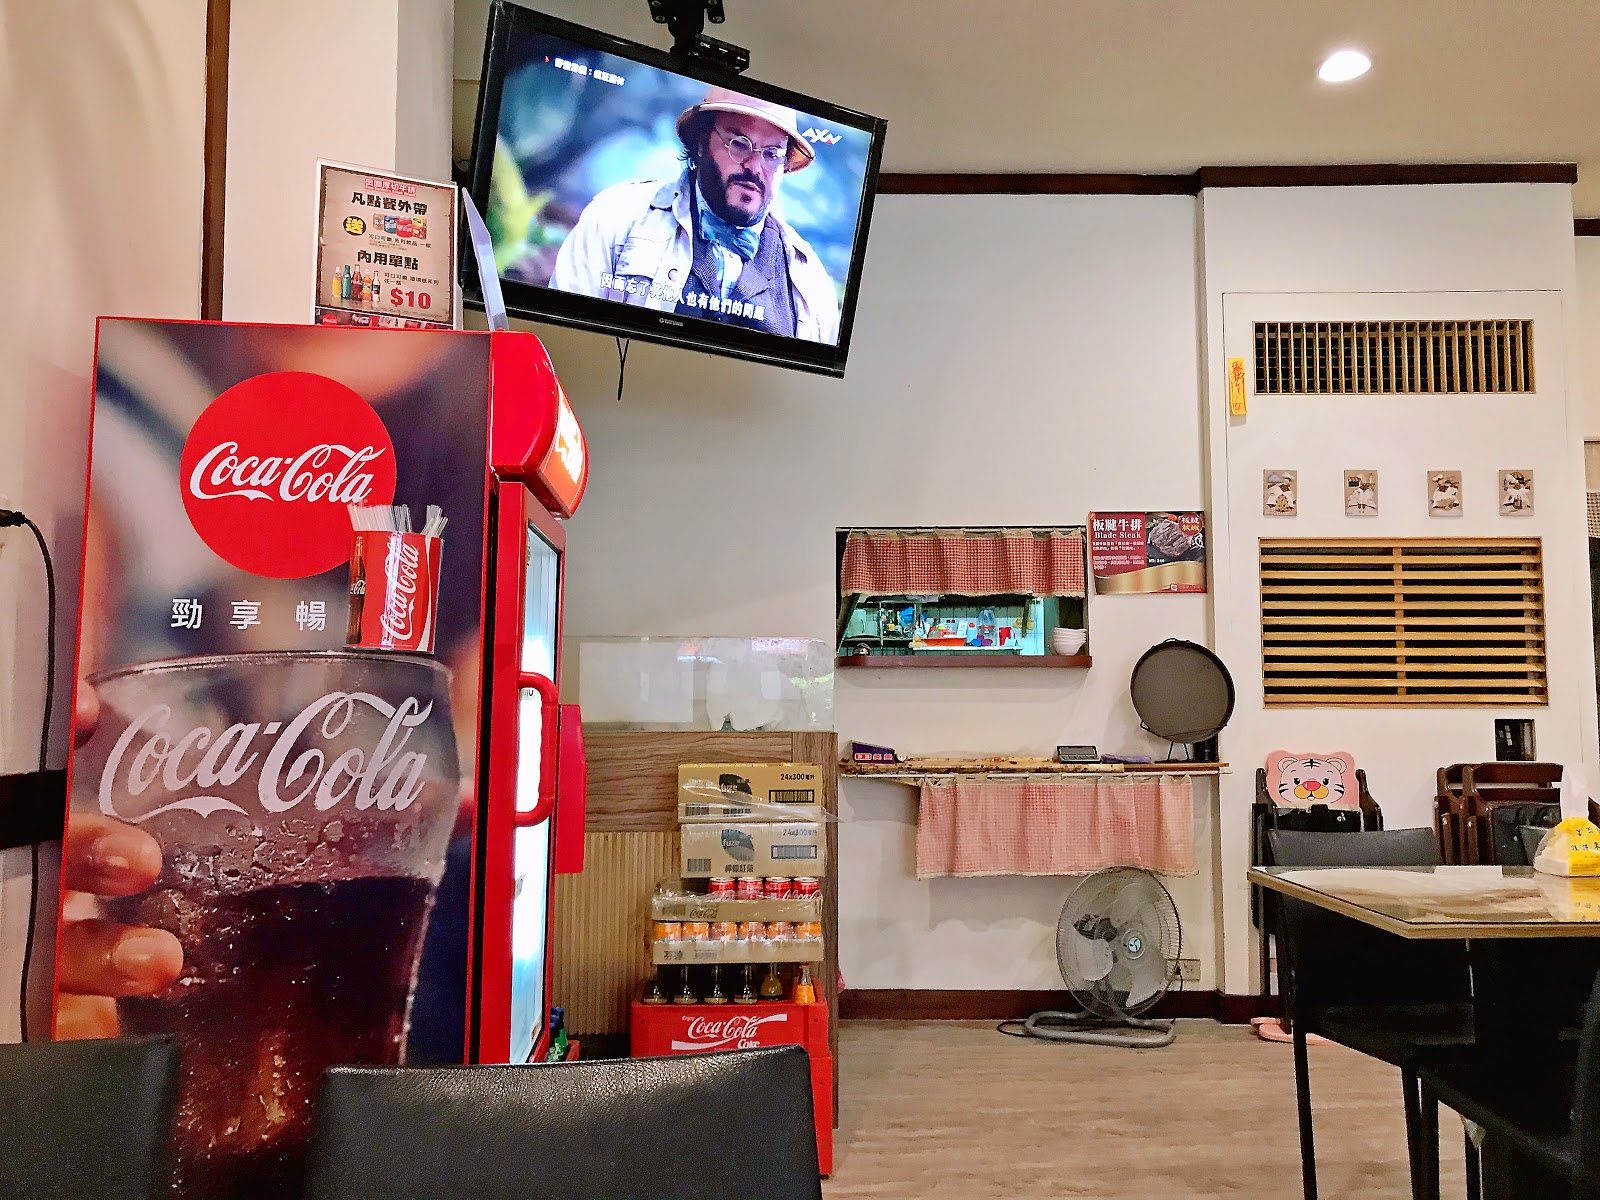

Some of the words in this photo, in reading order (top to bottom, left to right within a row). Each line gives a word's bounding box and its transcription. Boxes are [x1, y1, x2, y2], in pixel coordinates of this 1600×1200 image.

[801, 127, 843, 145] AXN
[351, 191, 428, 216] 凡點餐外帶
[357, 249, 419, 270] 內用單點
[390, 287, 432, 310] $10
[189, 441, 388, 503] Coca-Cola
[1095, 531, 1117, 539] Blade
[1119, 531, 1142, 539] Steak
[98, 691, 435, 824] Coca-Cola
[687, 1015, 761, 1040] Coca-Cola
[737, 1038, 761, 1049] Coke
